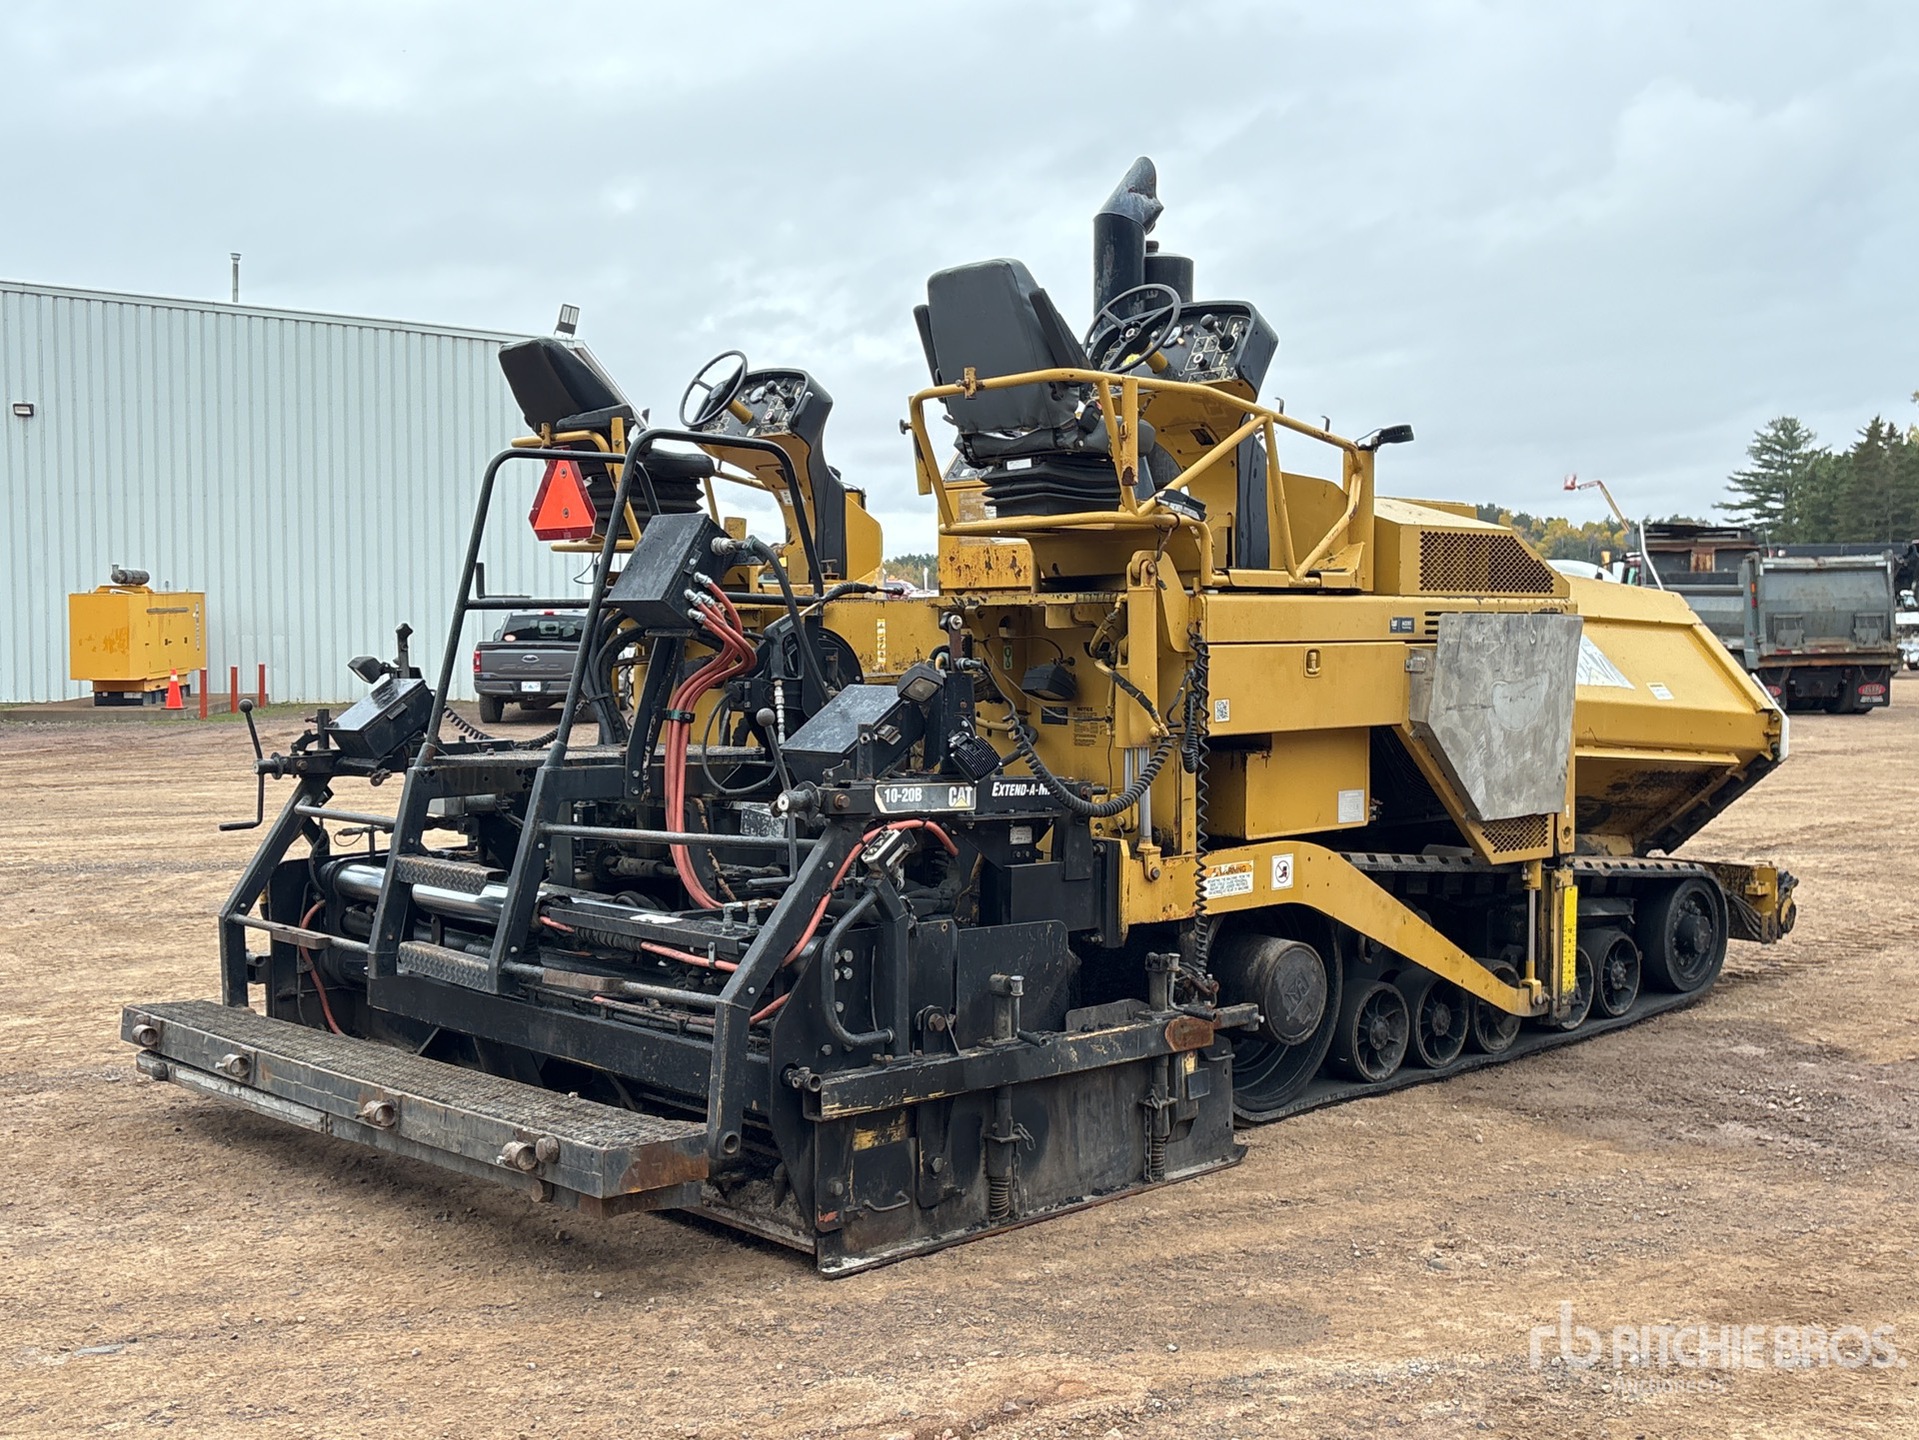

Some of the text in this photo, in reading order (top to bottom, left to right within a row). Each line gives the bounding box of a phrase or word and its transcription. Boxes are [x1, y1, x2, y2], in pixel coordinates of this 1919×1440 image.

[884, 786, 922, 803] 10-20B
[949, 786, 972, 807] CAT
[992, 782, 1052, 797] EXTEND-A-M
